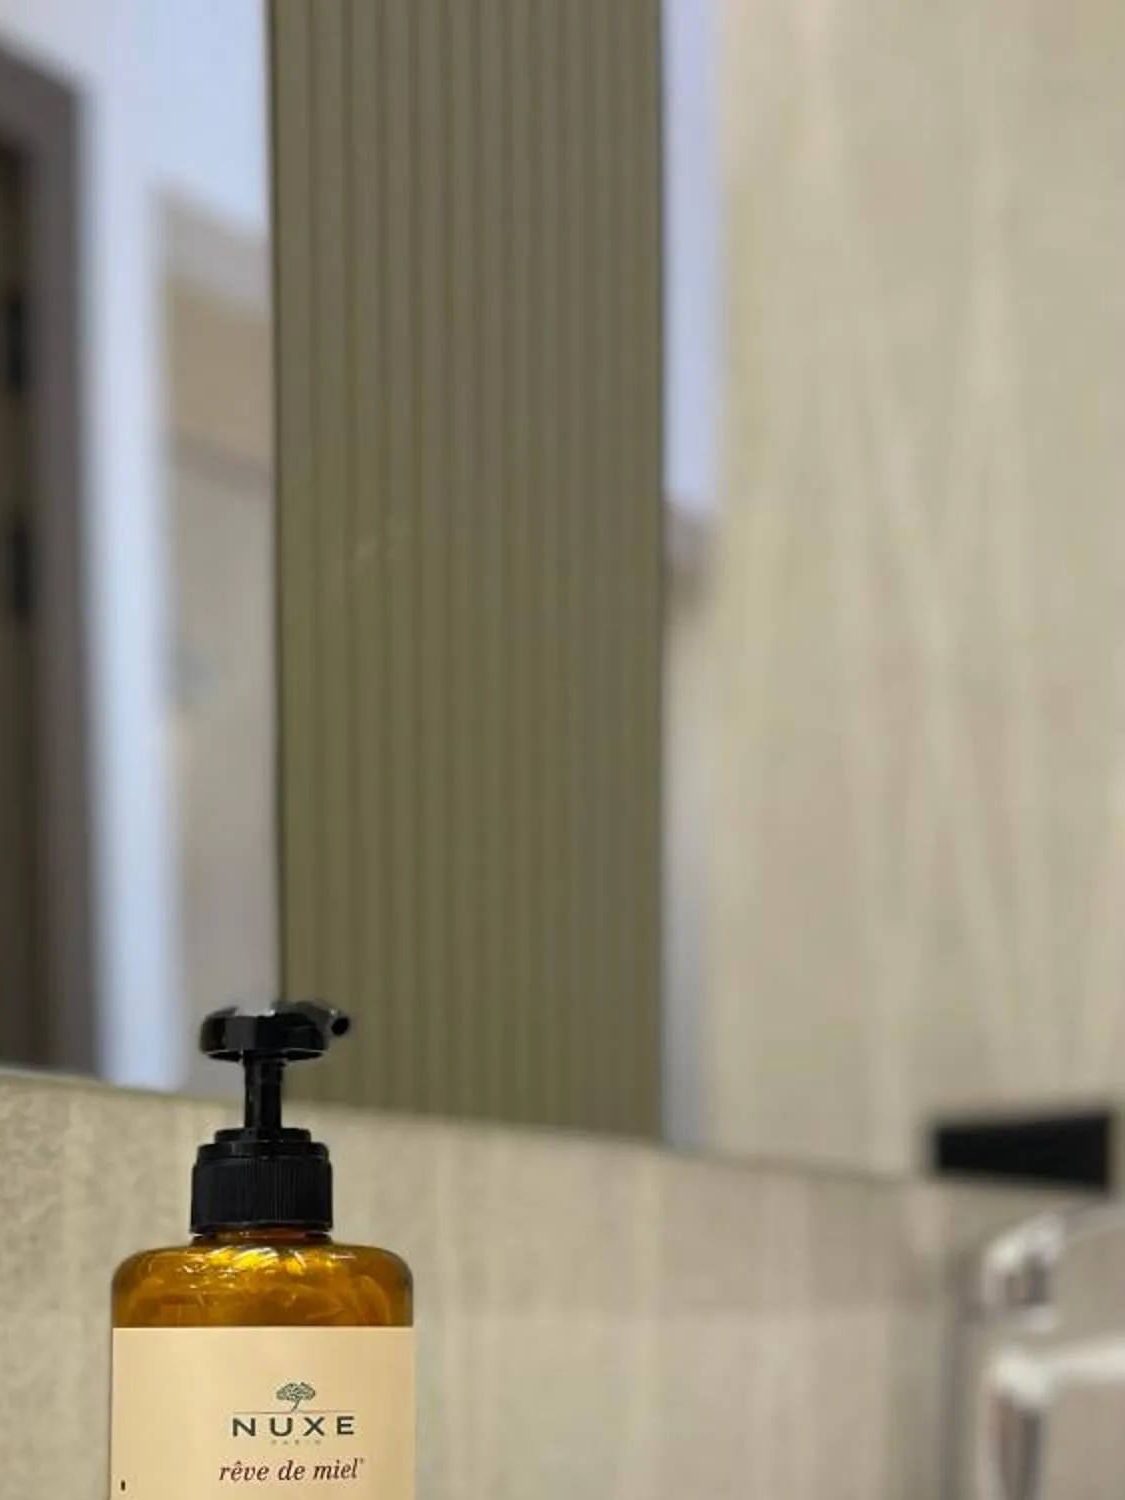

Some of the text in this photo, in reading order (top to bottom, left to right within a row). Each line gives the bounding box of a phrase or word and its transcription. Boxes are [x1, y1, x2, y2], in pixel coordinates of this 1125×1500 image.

[232, 1415, 355, 1437] NUXE
[218, 1460, 270, 1482] rêve
[277, 1460, 305, 1481] de
